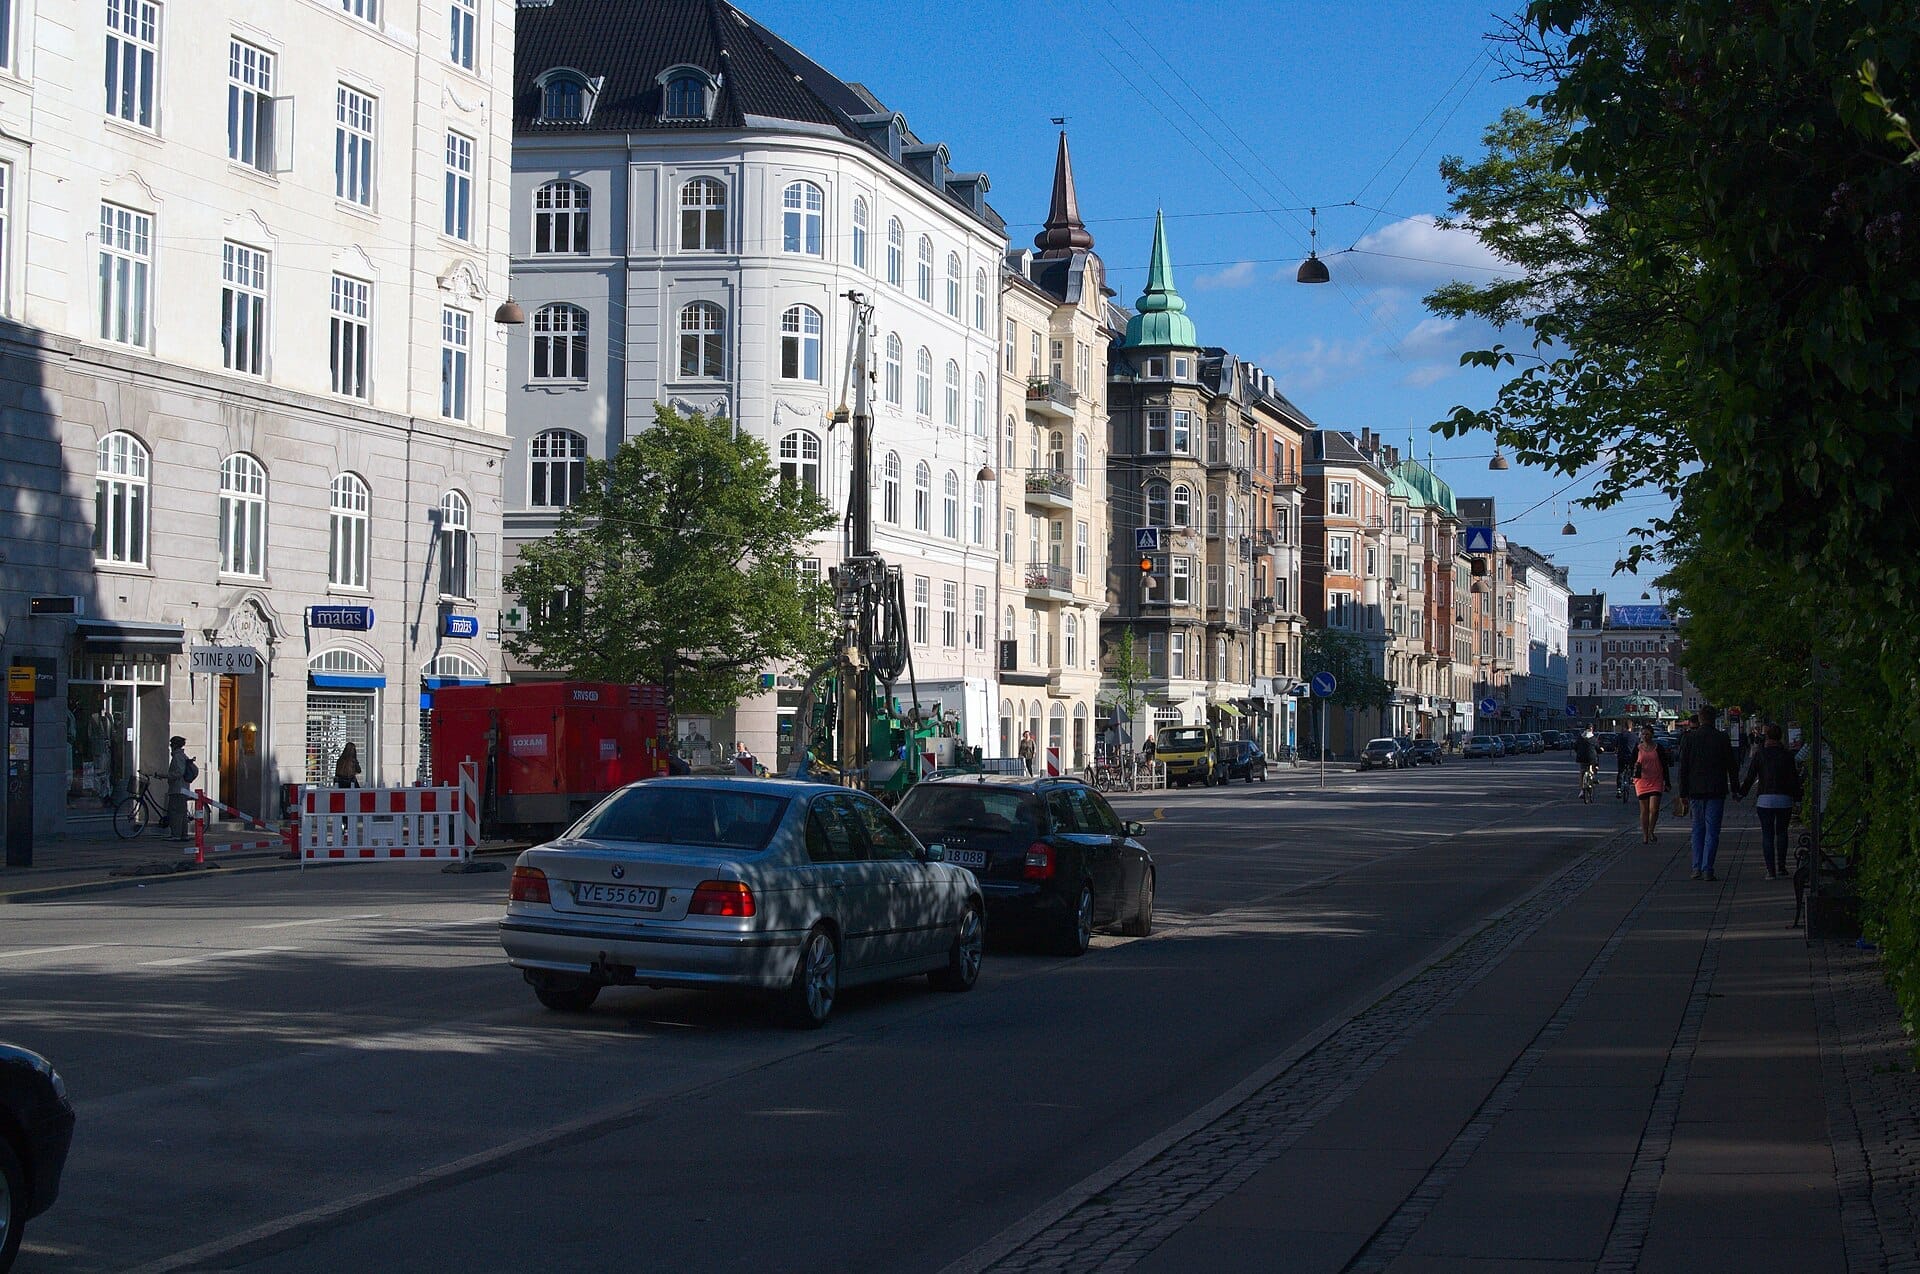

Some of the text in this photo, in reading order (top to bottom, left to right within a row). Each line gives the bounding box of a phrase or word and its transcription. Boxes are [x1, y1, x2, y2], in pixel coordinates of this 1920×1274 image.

[317, 610, 361, 625] matas
[451, 620, 473, 633] matas
[193, 652, 253, 668] STINE & KO
[512, 738, 543, 747] LOXAM
[948, 850, 984, 863] 18 088
[583, 886, 602, 901] YE
